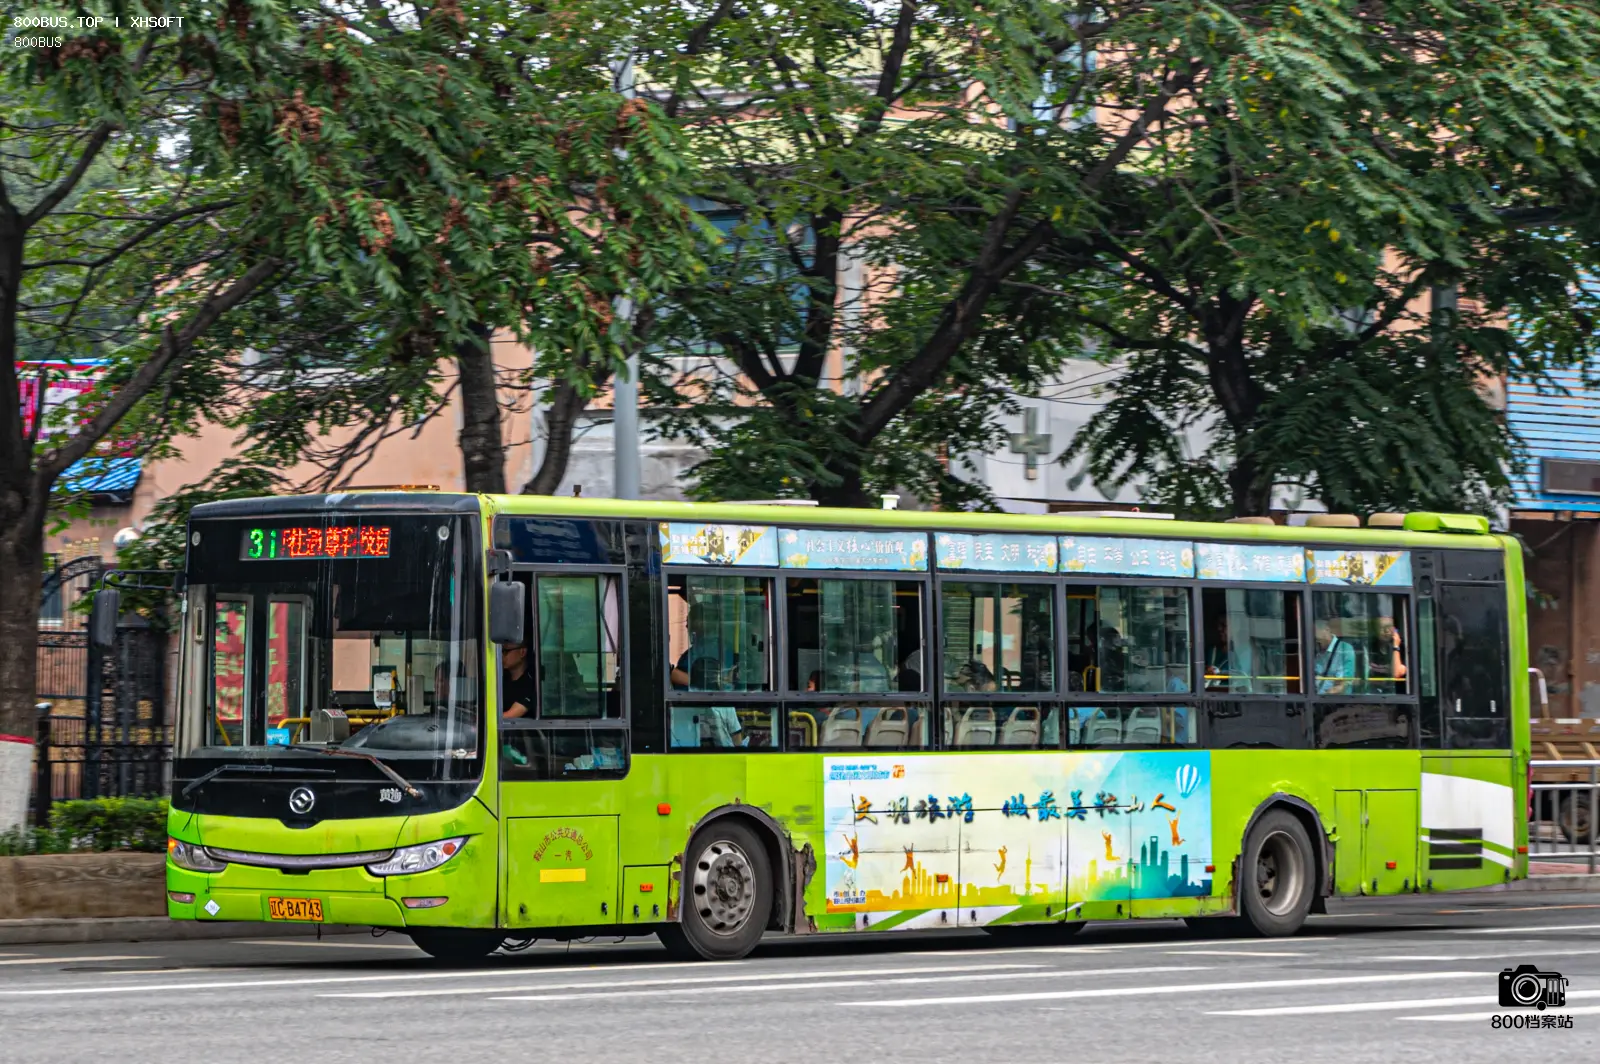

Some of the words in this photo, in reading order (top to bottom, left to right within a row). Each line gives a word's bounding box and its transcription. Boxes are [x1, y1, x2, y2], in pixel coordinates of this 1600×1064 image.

[248, 528, 277, 558] 31
[854, 792, 975, 825] 文明旅游
[1001, 789, 1176, 822] 做最美鞍山人
